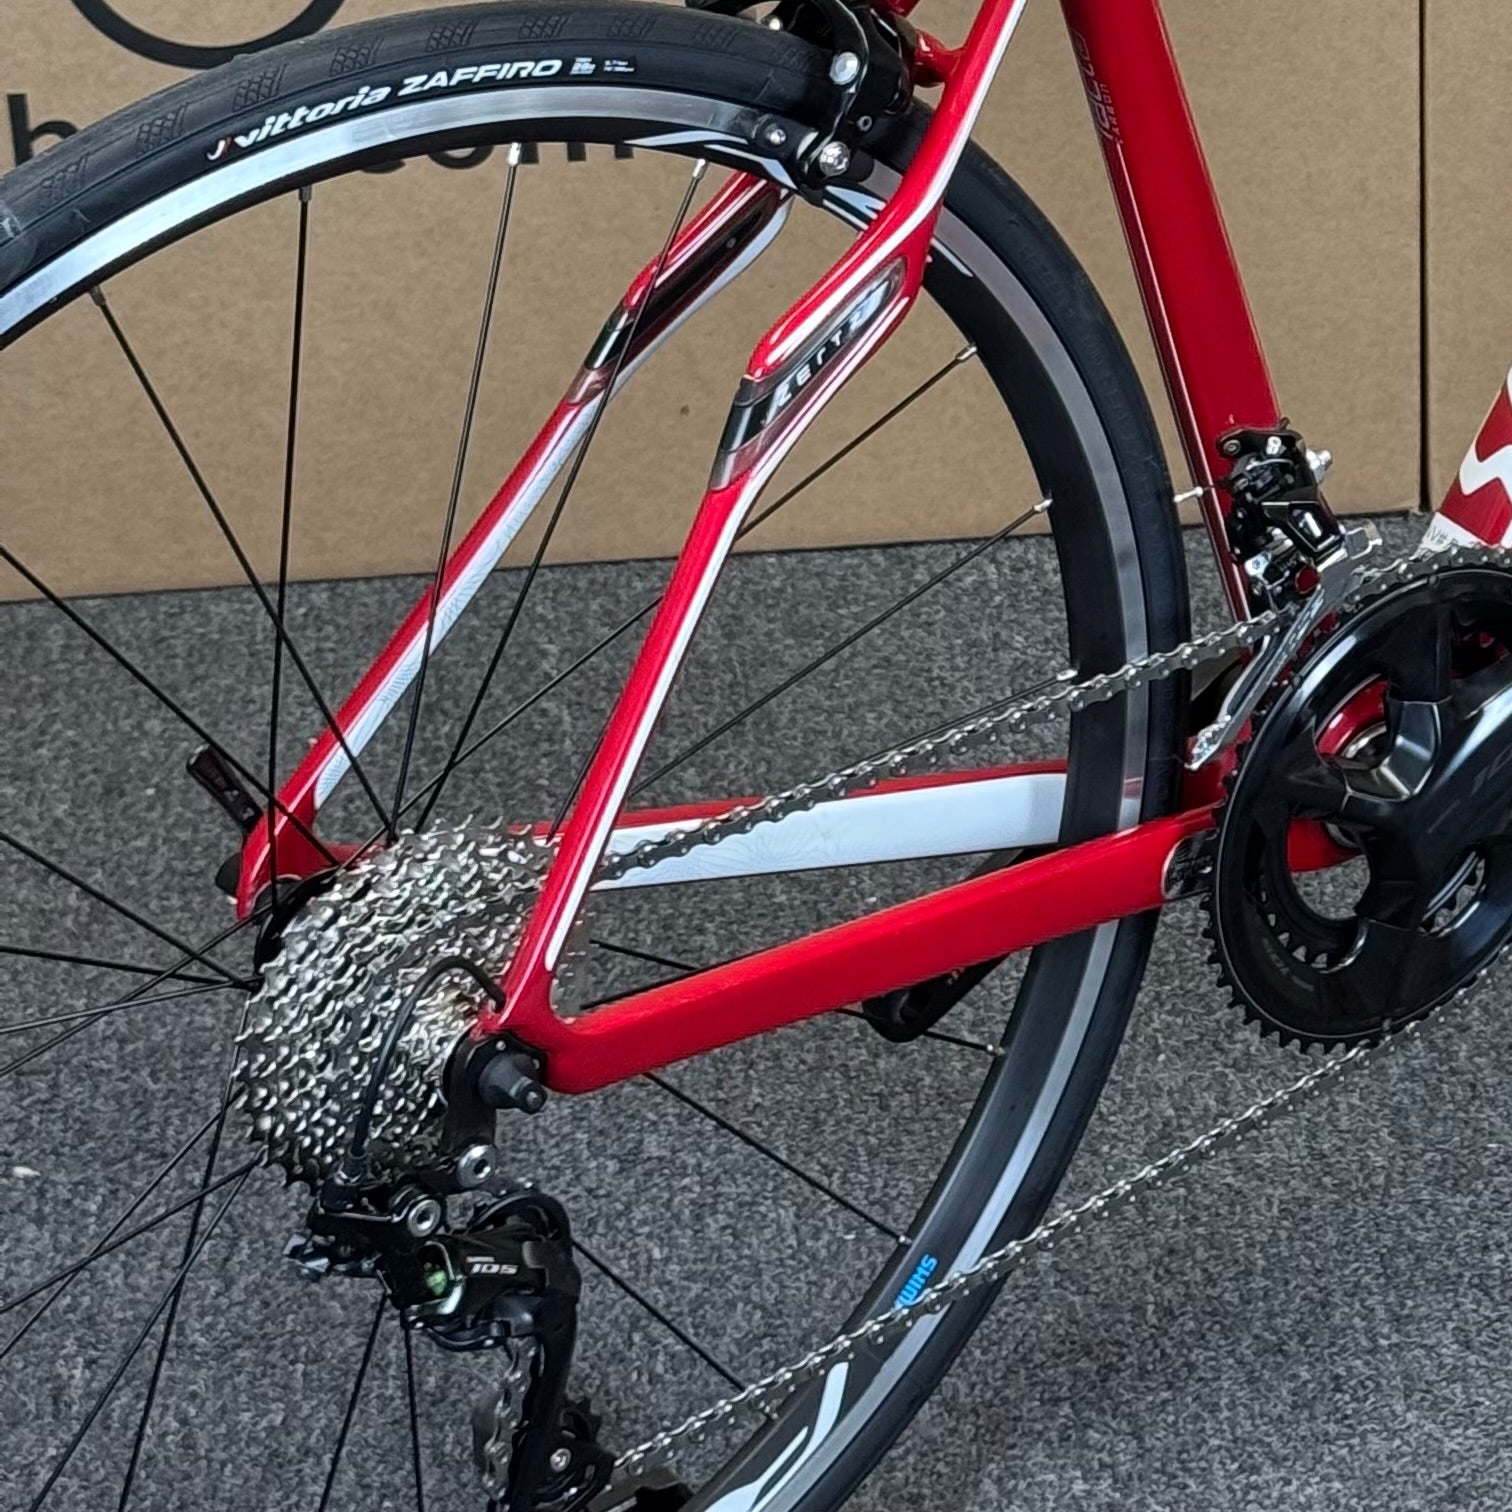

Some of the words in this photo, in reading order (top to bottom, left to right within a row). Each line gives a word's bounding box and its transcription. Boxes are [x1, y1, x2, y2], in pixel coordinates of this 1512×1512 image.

[237, 85, 392, 149] vittoria
[397, 59, 564, 97] ZAFFIRO
[470, 1263, 519, 1275] 105
